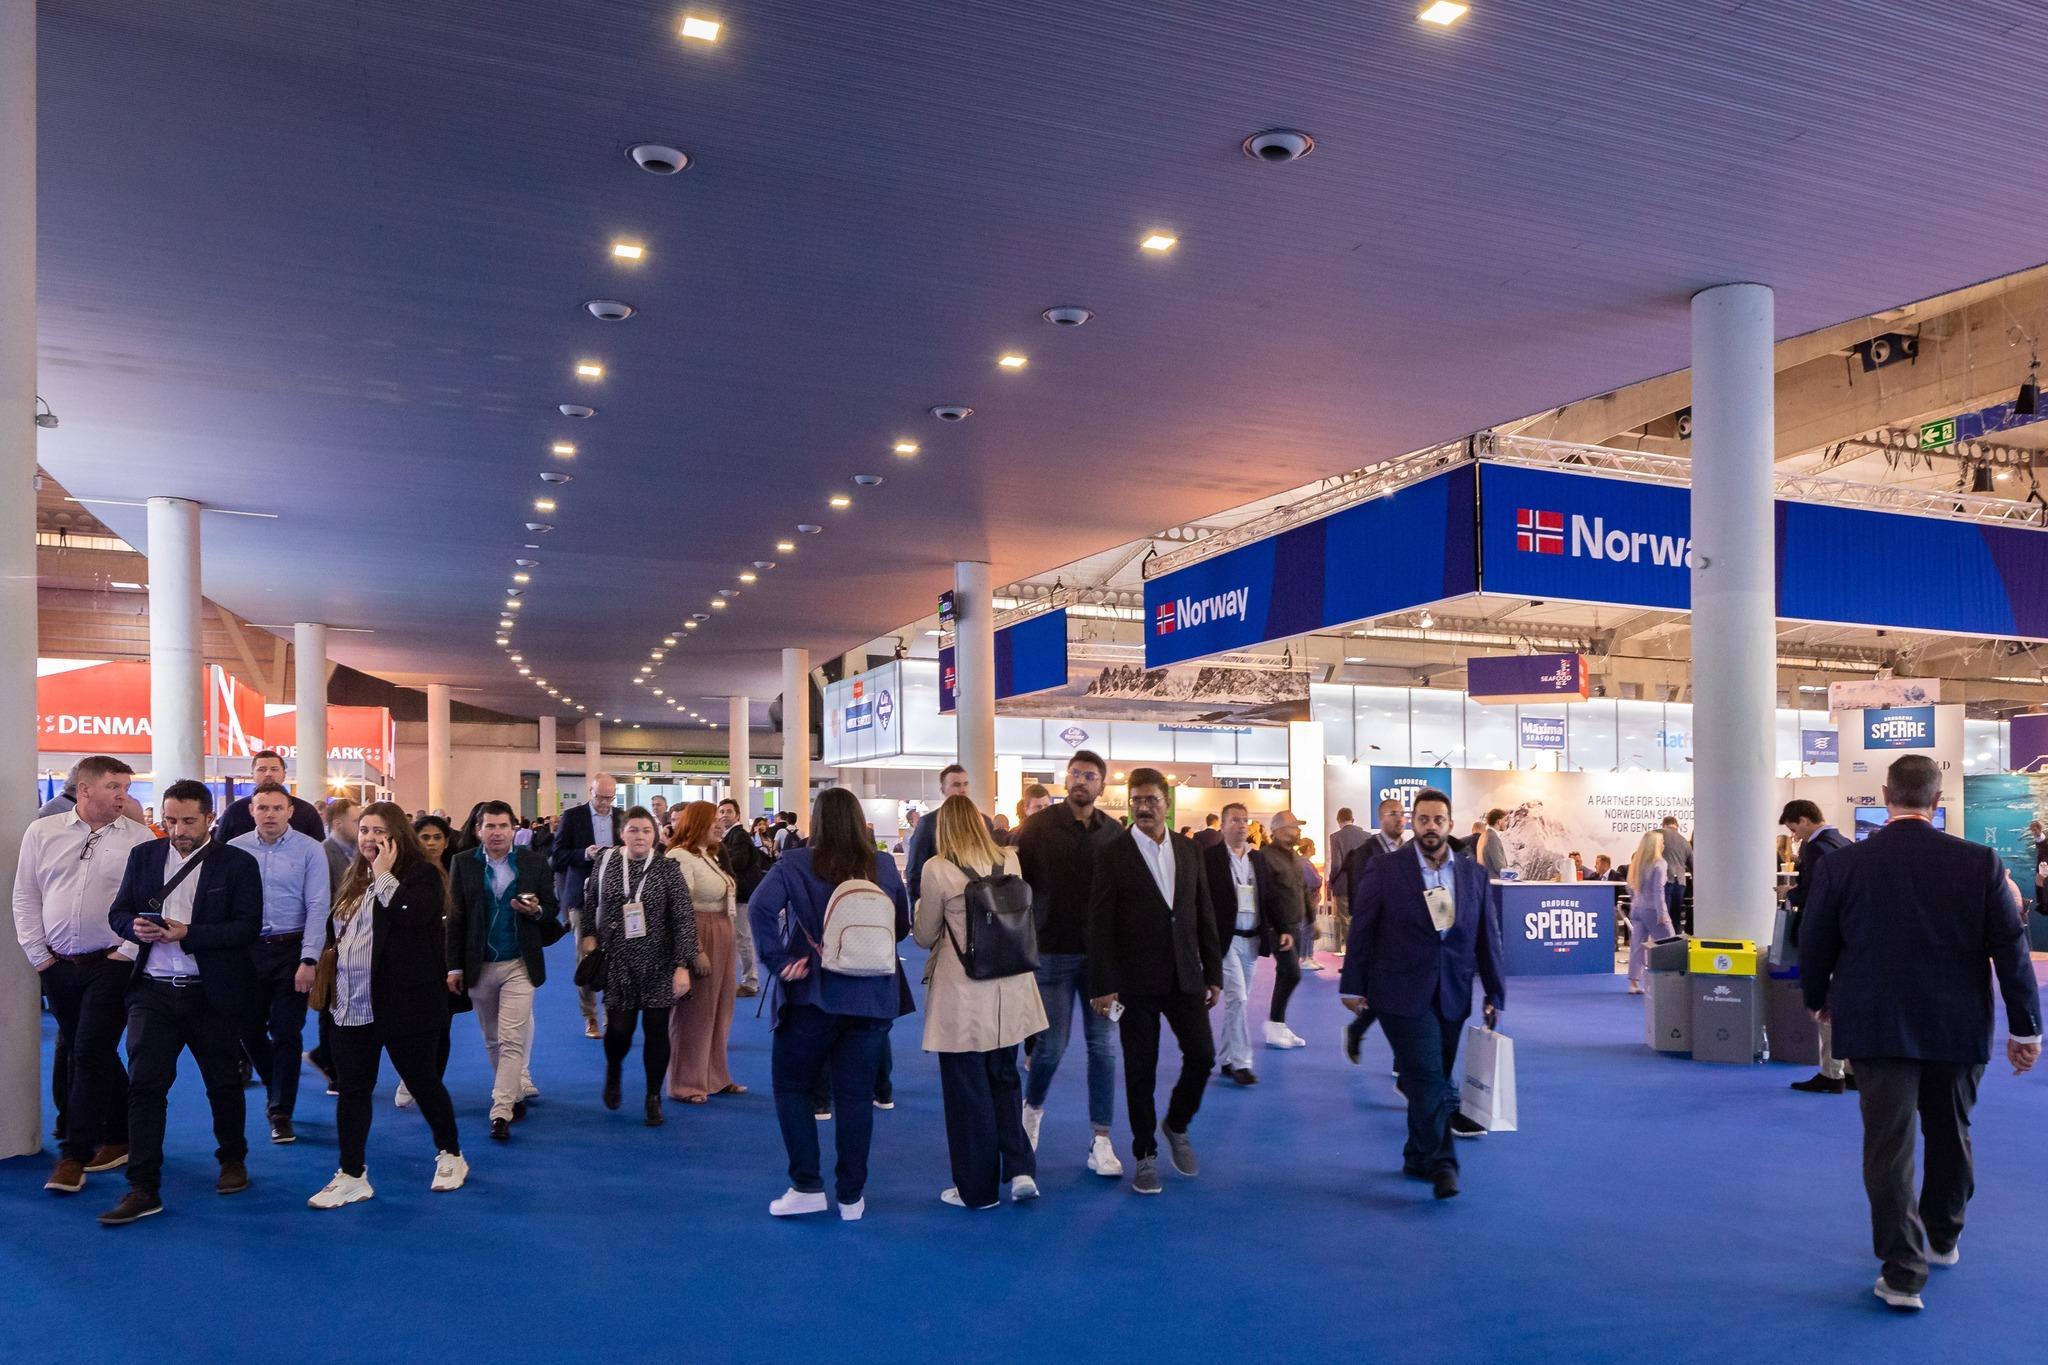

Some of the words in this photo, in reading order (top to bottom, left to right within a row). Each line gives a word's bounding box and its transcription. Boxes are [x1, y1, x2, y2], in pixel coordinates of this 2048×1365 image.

[1572, 514, 1691, 568] Norw
[1177, 586, 1249, 631] Norway
[58, 715, 152, 736] DENMA
[1871, 720, 1927, 739] SPERRE
[1526, 734, 1561, 742] SEAFOOD
[275, 745, 365, 760] DEARK
[1588, 796, 1594, 805] A
[1596, 796, 1635, 806] PARTNER
[1637, 797, 1653, 806] FOR
[1655, 797, 1694, 807] SUSTAINA
[1605, 809, 1655, 819] NORWEGIAN
[1612, 823, 1629, 832] FOR
[1525, 908, 1598, 940] SPERRE
